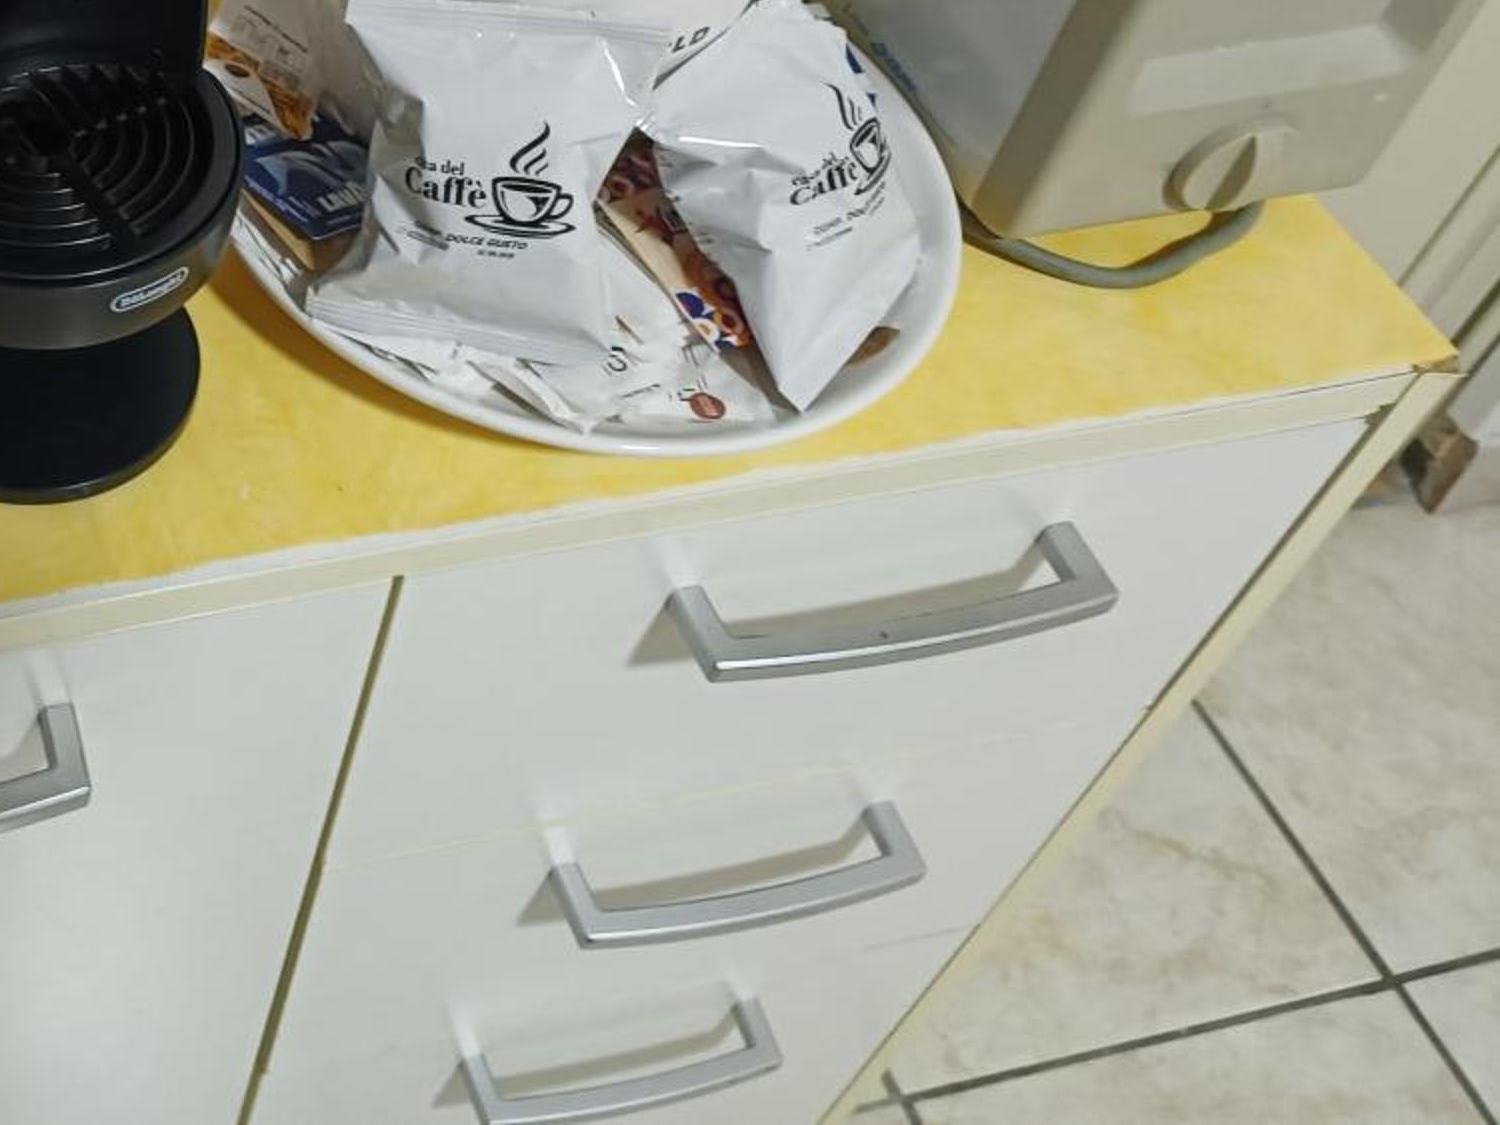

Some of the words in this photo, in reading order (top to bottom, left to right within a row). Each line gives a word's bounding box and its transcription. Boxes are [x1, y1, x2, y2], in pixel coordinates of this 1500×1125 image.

[440, 160, 465, 176] del
[404, 167, 487, 209] Caffè
[446, 233, 485, 247] DOLCE
